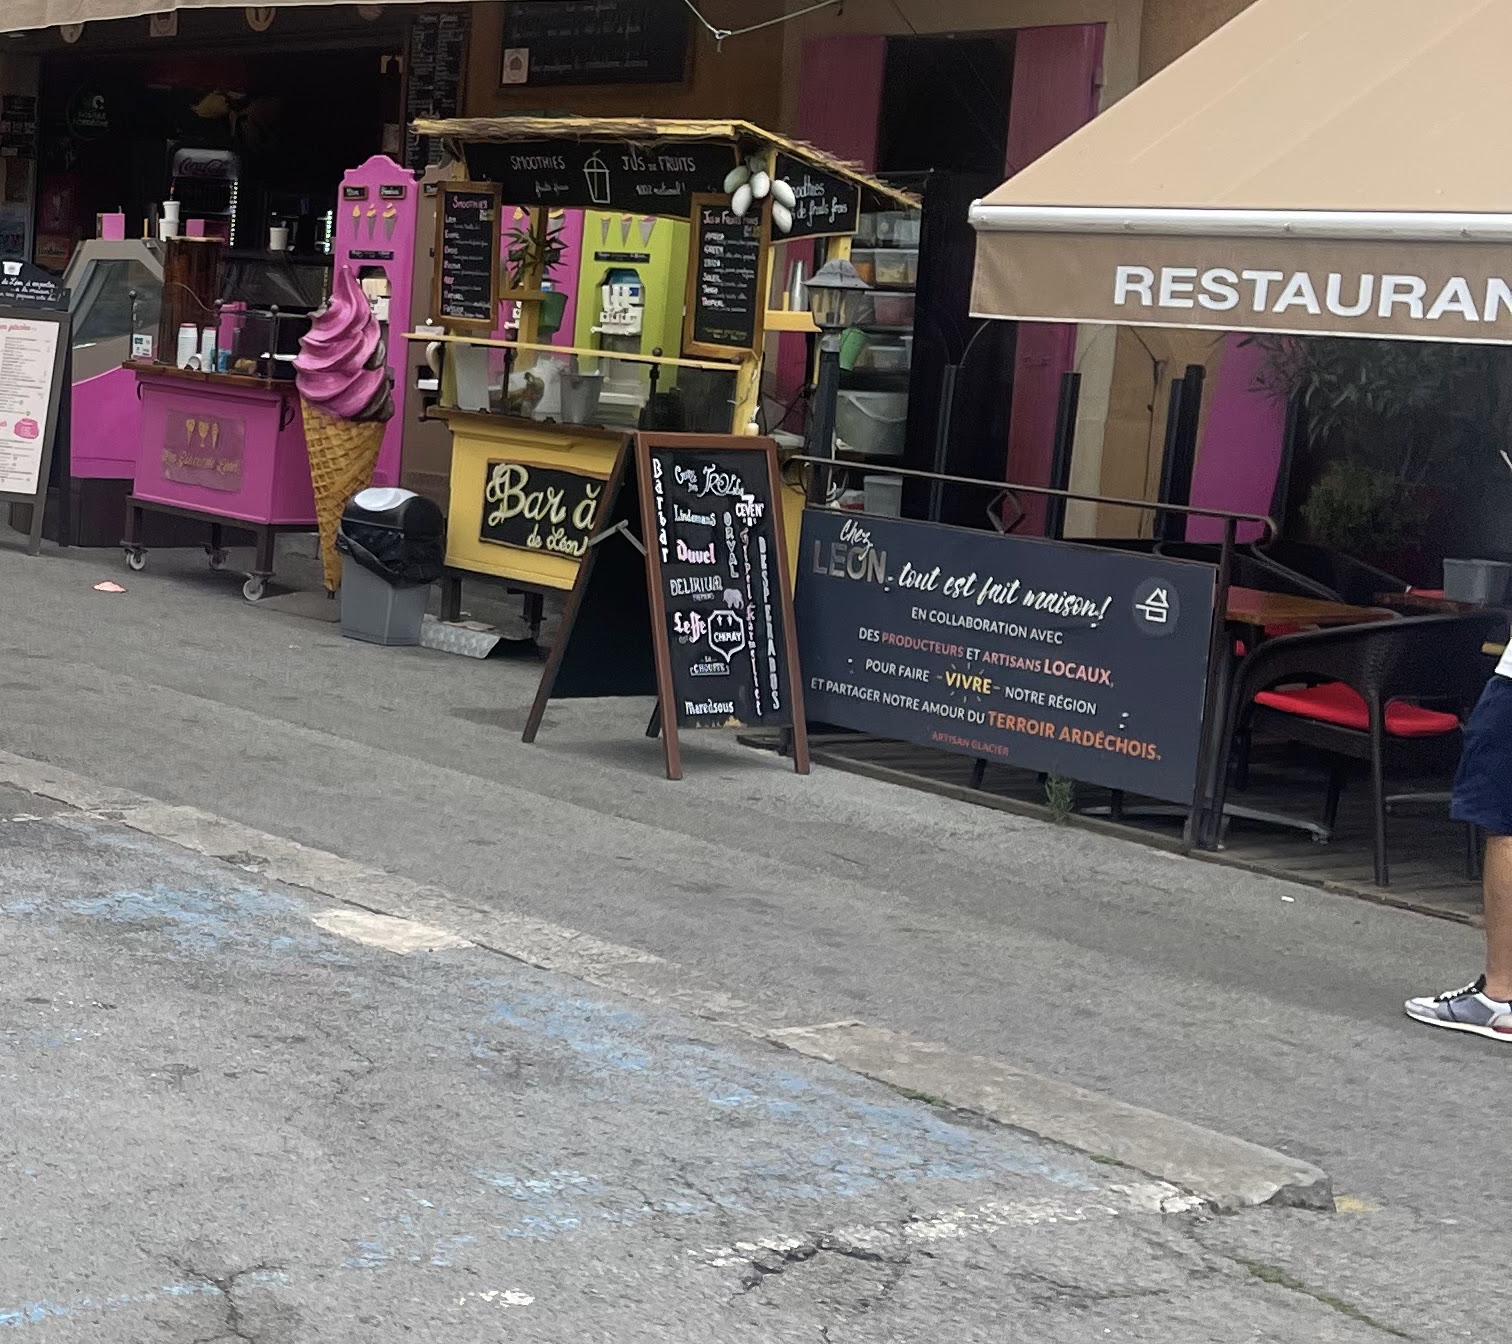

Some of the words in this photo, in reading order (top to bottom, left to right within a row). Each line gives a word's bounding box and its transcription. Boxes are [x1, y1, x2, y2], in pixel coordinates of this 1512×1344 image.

[509, 154, 566, 171] SMOOTHIES
[622, 153, 646, 172] JUS
[658, 156, 696, 173] FRUITS
[486, 463, 567, 527] Bar
[526, 523, 543, 548] de
[676, 539, 717, 565] Duvel
[840, 519, 874, 561] Chez
[898, 562, 942, 592] tout
[943, 572, 978, 599] est
[976, 576, 1021, 606] fait
[1022, 588, 1113, 621] maison!
[674, 611, 708, 644] Leffe
[758, 536, 781, 711] DESPERADOS
[911, 606, 927, 621] EN
[928, 610, 1028, 639] COLLABORATION
[1029, 630, 1064, 645] AVEC
[859, 627, 880, 642] DES
[881, 630, 965, 658] PRODUCTEURS
[966, 647, 981, 661] ET
[982, 650, 1041, 672] ARTISANS
[1043, 658, 1114, 688] LOCAUX,
[865, 658, 896, 676] POUR
[898, 665, 930, 683] FAIRE
[945, 670, 993, 695] VIVRE
[1004, 686, 1046, 706] NOTRE
[1047, 694, 1098, 715] RÉGION
[685, 699, 735, 716] Maredsous
[811, 677, 825, 690] ET
[825, 679, 881, 703] PARTAGER
[882, 692, 920, 711] NOTRE
[921, 700, 966, 721] AMOUR
[967, 710, 986, 725] DU
[987, 710, 1055, 740] TERROIR
[931, 731, 970, 747] ARTISAN
[970, 738, 1009, 756] GLACIER
